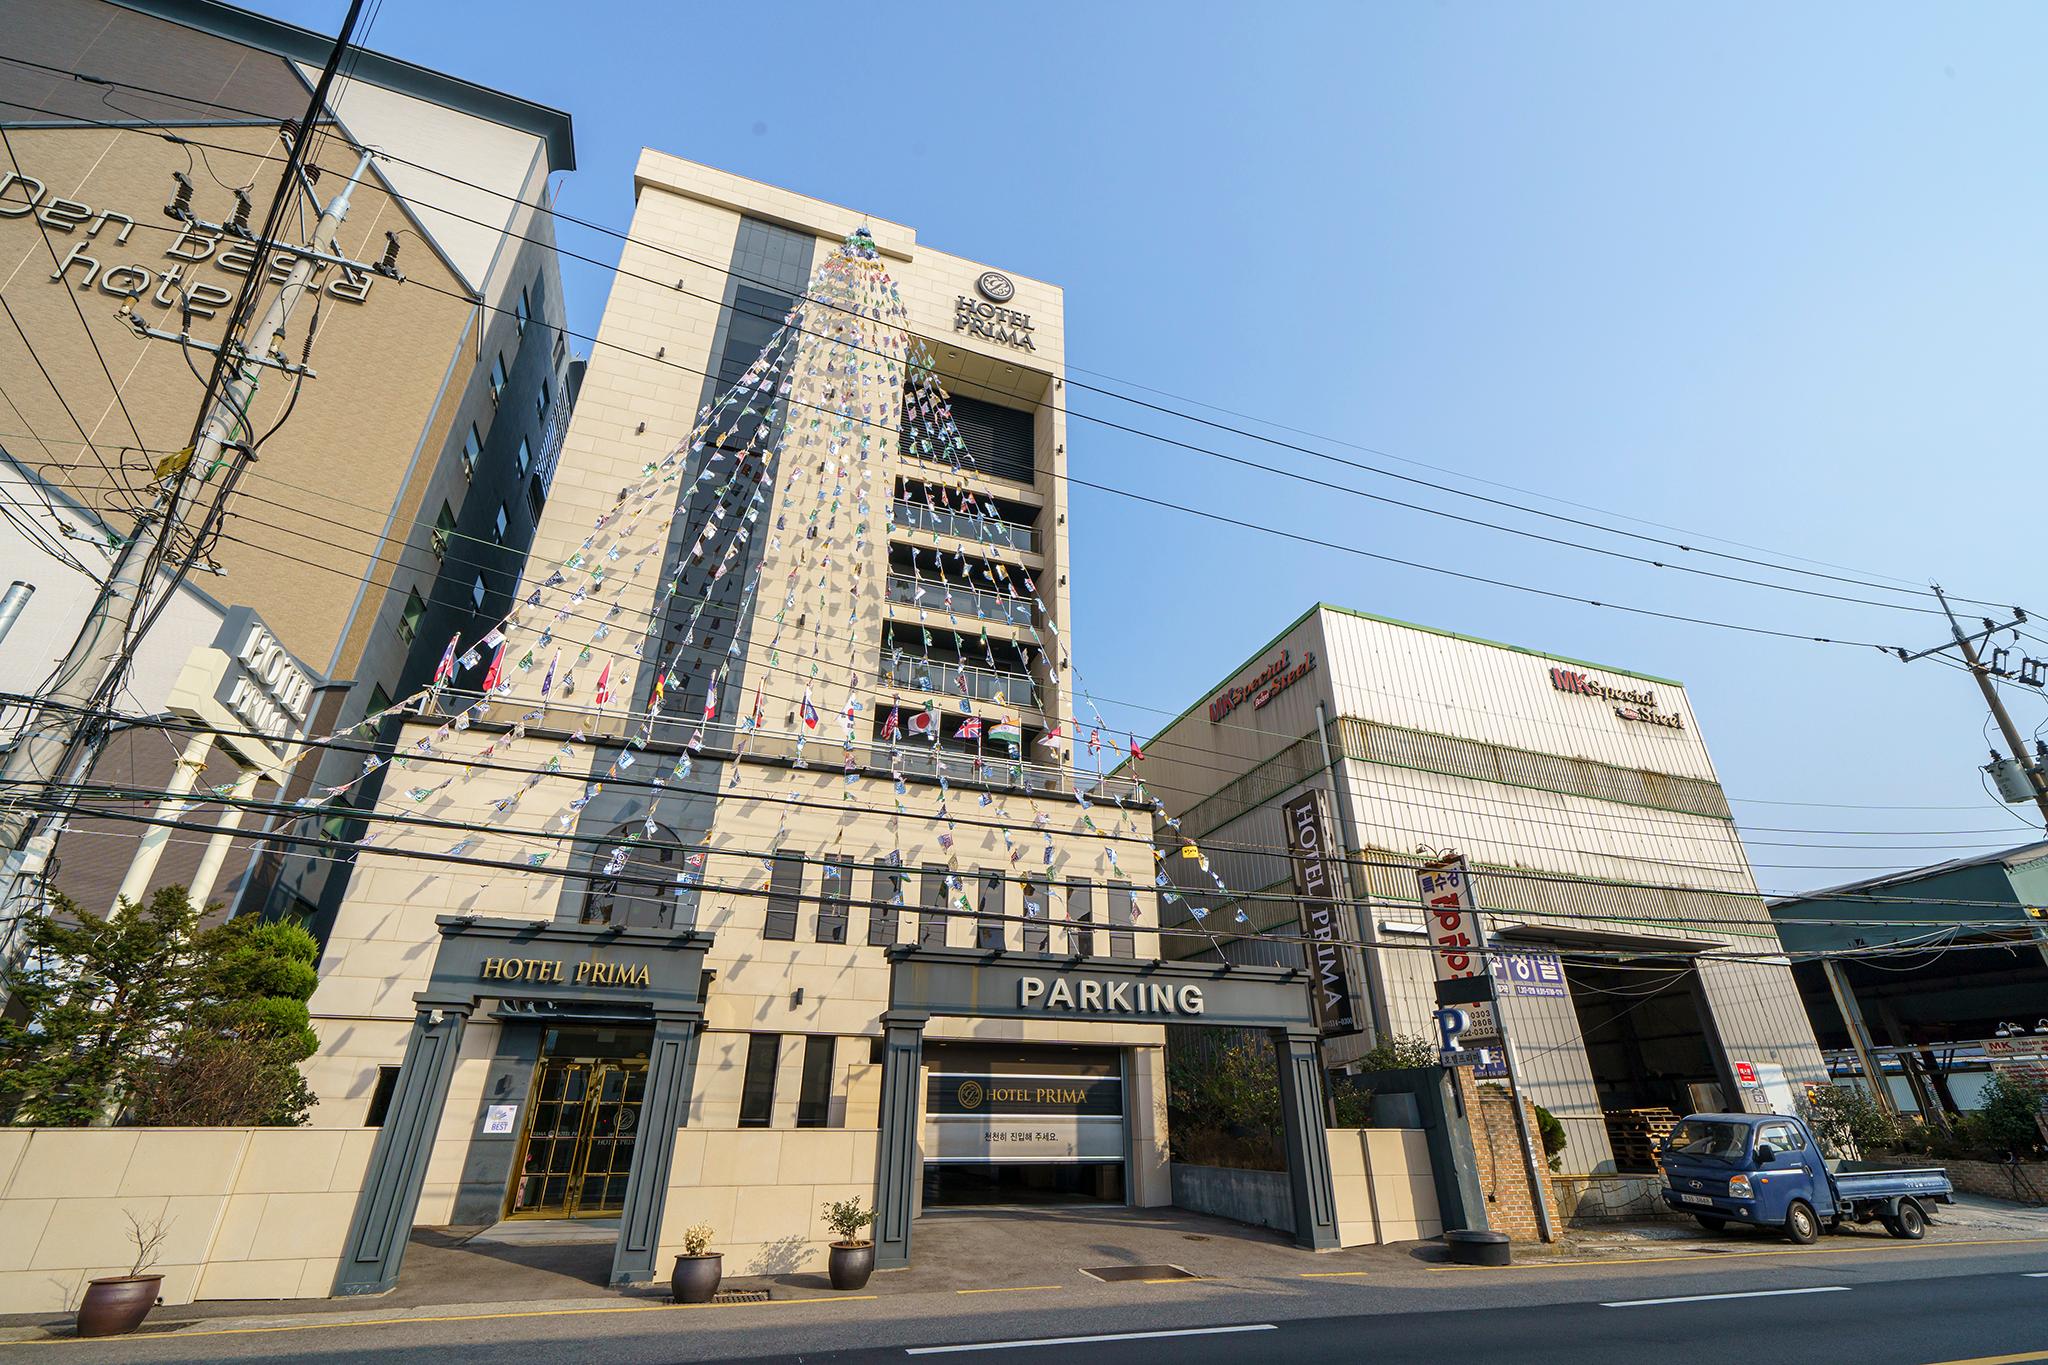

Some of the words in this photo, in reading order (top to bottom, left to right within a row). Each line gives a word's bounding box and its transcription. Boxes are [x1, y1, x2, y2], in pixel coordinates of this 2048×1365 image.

[0, 170, 136, 244] Den
[50, 241, 245, 320] hote
[956, 295, 1035, 331] HOTEL
[956, 312, 1037, 351] PRIMA
[237, 621, 314, 722] HOTEL
[1232, 649, 1291, 705] Special
[1271, 649, 1317, 697] Steel
[1549, 667, 1593, 697] MK
[1588, 680, 1658, 707] Special
[227, 675, 289, 750] PRIMA
[1637, 705, 1686, 730] Steel
[1421, 867, 1460, 894] 특수강
[1295, 801, 1324, 896] HOTEL
[1311, 907, 1343, 1013] PRIMA
[481, 956, 565, 982] HOTEL
[575, 960, 651, 986] PRIMA
[1019, 976, 1206, 1015] PARKING
[1433, 1007, 1468, 1052] P
[1988, 1041, 2013, 1050] MK
[986, 1088, 1032, 1102] HOTEL
[1036, 1088, 1088, 1104] PRIMA
[491, 1123, 509, 1131] BEST
[984, 1132, 1008, 1142] 천천히
[1010, 1132, 1033, 1142] 진입해
[1035, 1132, 1059, 1142] 주세요.
